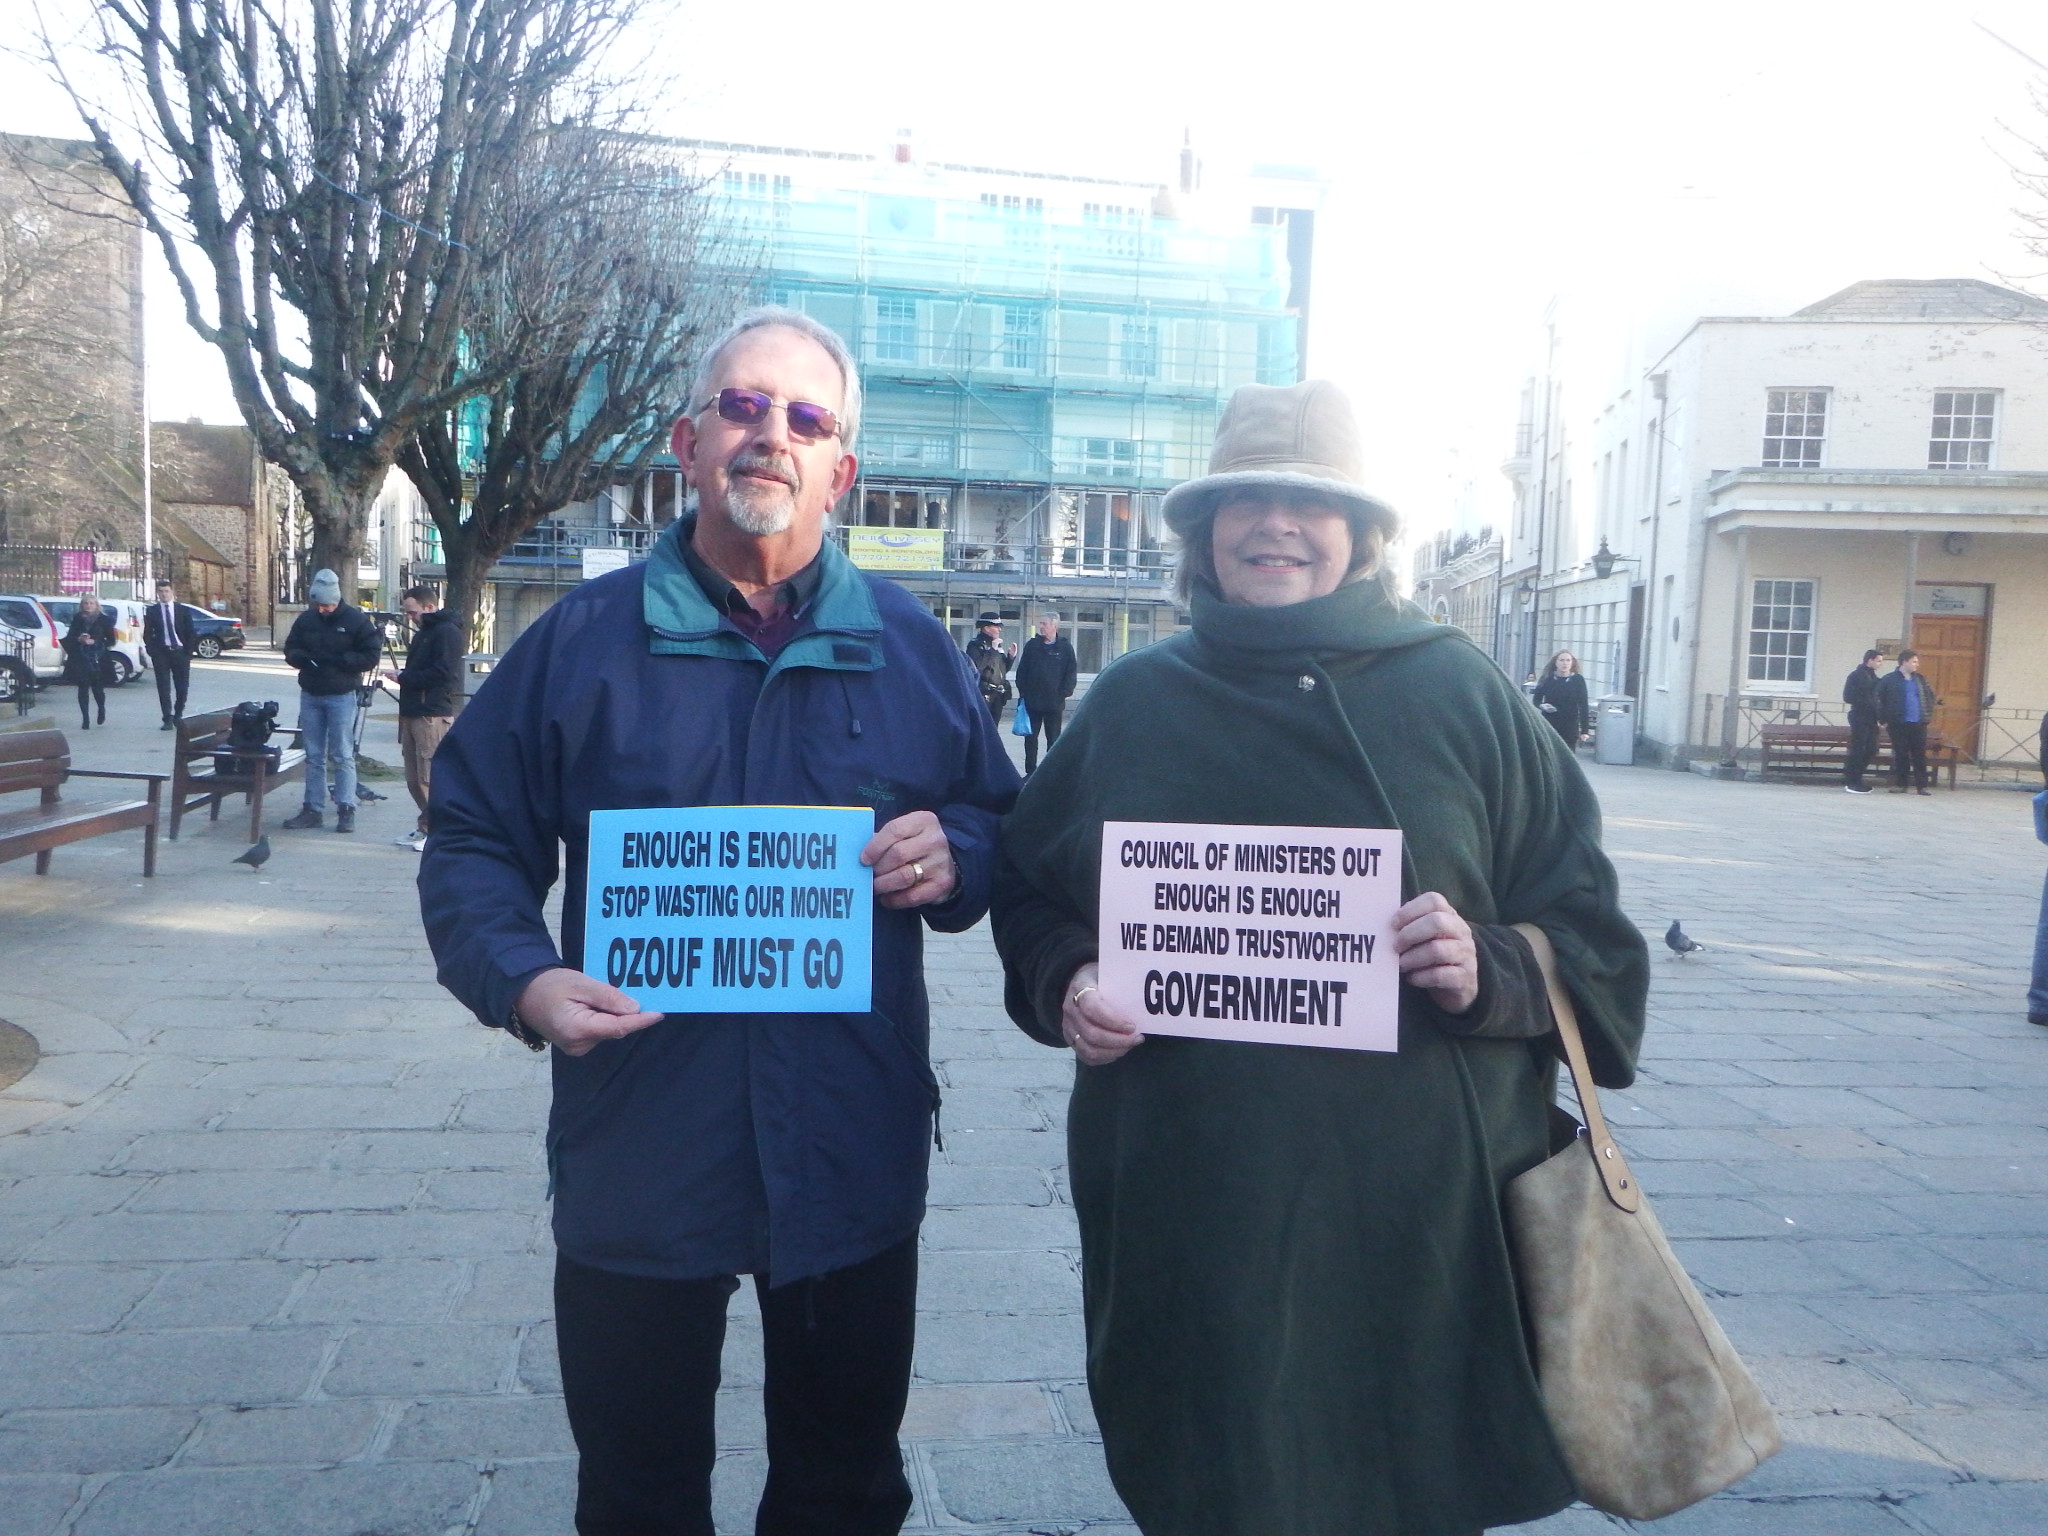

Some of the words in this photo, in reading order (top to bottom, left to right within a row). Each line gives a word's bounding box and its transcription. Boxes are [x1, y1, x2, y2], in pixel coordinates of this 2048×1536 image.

[623, 831, 711, 868] ENOUGH
[719, 831, 739, 868] IS
[748, 832, 836, 870] ENOUGH
[1121, 840, 1199, 869] COUNCIL
[1205, 843, 1229, 871] OF
[1235, 844, 1335, 875] MINISTERS
[1343, 847, 1381, 877] OUT
[602, 885, 650, 918] STOP
[655, 885, 738, 917] WASTING
[745, 885, 784, 917] OUR
[791, 887, 854, 919] MONEY
[1155, 883, 1229, 913] ENOUGH
[1237, 886, 1254, 914] IS
[1261, 887, 1340, 918] ENOUGH
[1121, 923, 1147, 950] WE
[1153, 925, 1229, 955] DEMAND
[1236, 929, 1375, 963] TRUSTWORTHY
[607, 937, 703, 988] OZOUF
[713, 937, 794, 989] MUST
[804, 938, 843, 989] GO
[1144, 970, 1347, 1026] GOVERNMENT
